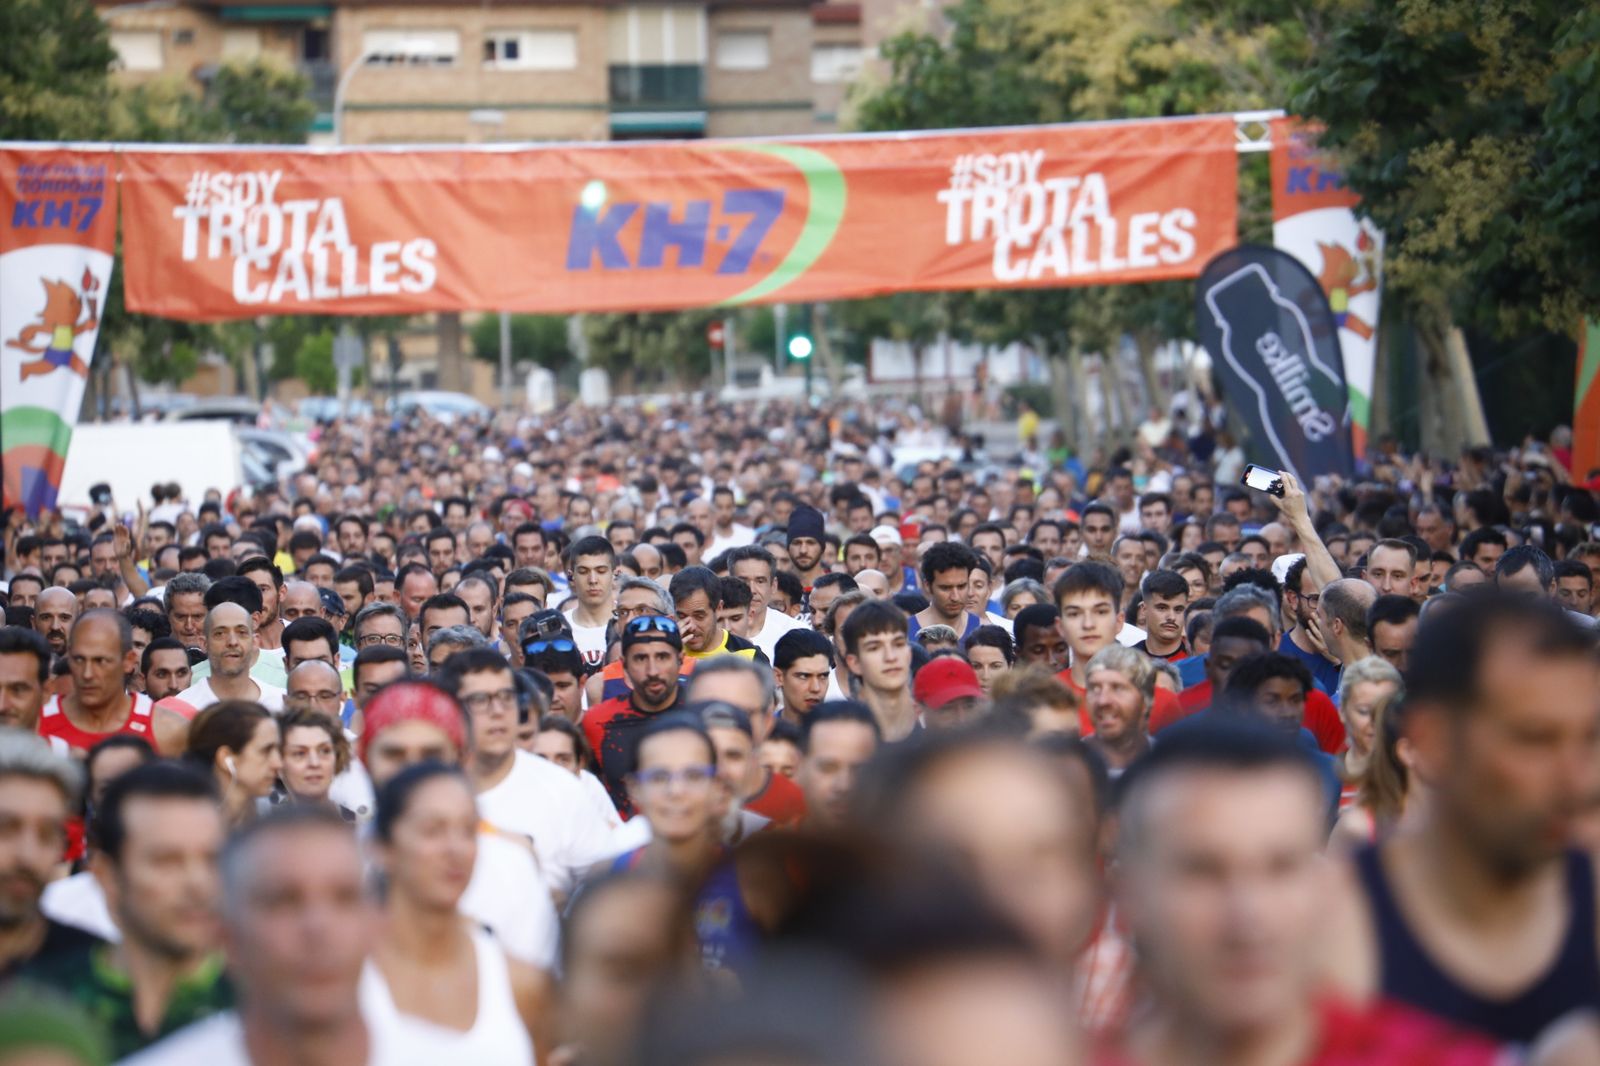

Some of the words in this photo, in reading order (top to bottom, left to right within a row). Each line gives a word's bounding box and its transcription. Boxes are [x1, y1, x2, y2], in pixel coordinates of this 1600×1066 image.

[185, 170, 283, 208] #SOY
[950, 149, 1045, 189] #SOY
[172, 197, 350, 261] TROTA
[936, 172, 1111, 246] TROTA
[232, 237, 438, 305] CALLES
[992, 208, 1198, 283] CALLES
